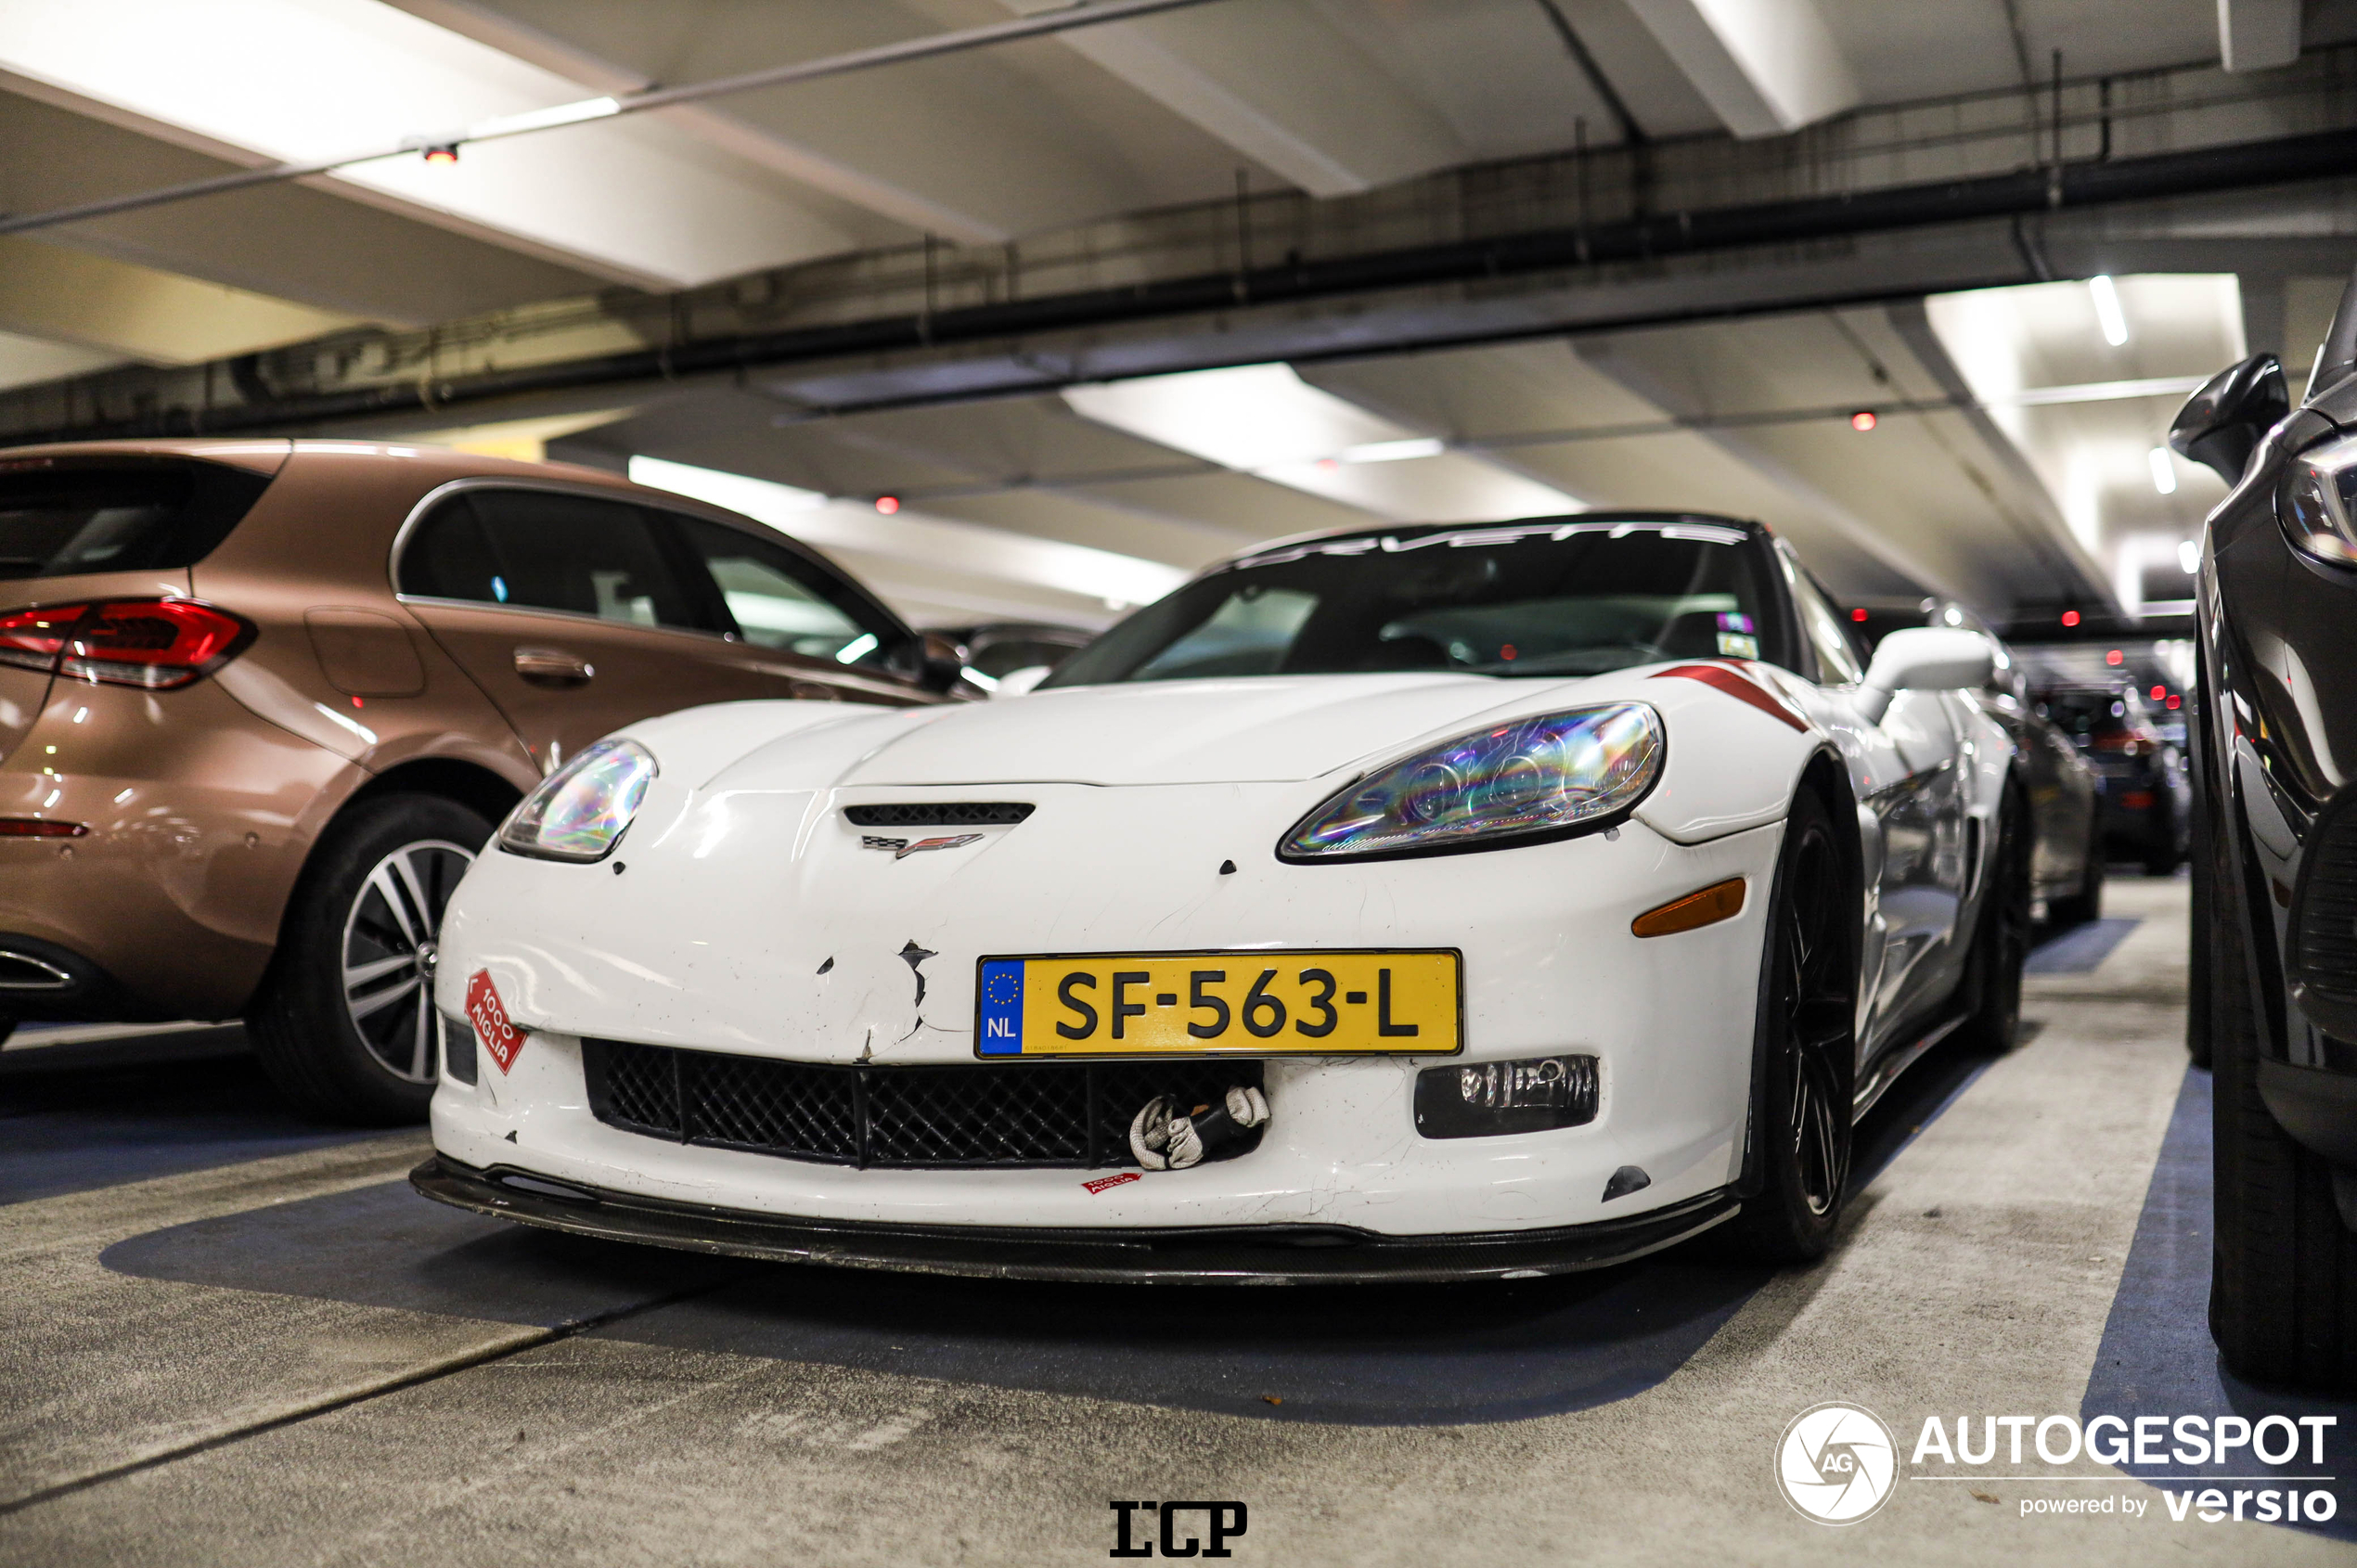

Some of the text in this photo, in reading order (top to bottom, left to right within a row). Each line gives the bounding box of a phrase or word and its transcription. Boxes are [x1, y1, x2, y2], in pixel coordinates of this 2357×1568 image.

[483, 988, 514, 1040] 1000
[1054, 968, 1420, 1040] SF-563-L
[471, 1003, 509, 1063] MIGLIA
[986, 1017, 1017, 1038] NL
[1088, 1175, 1125, 1187] 1000
[1090, 1176, 1134, 1193] MIGLIA
